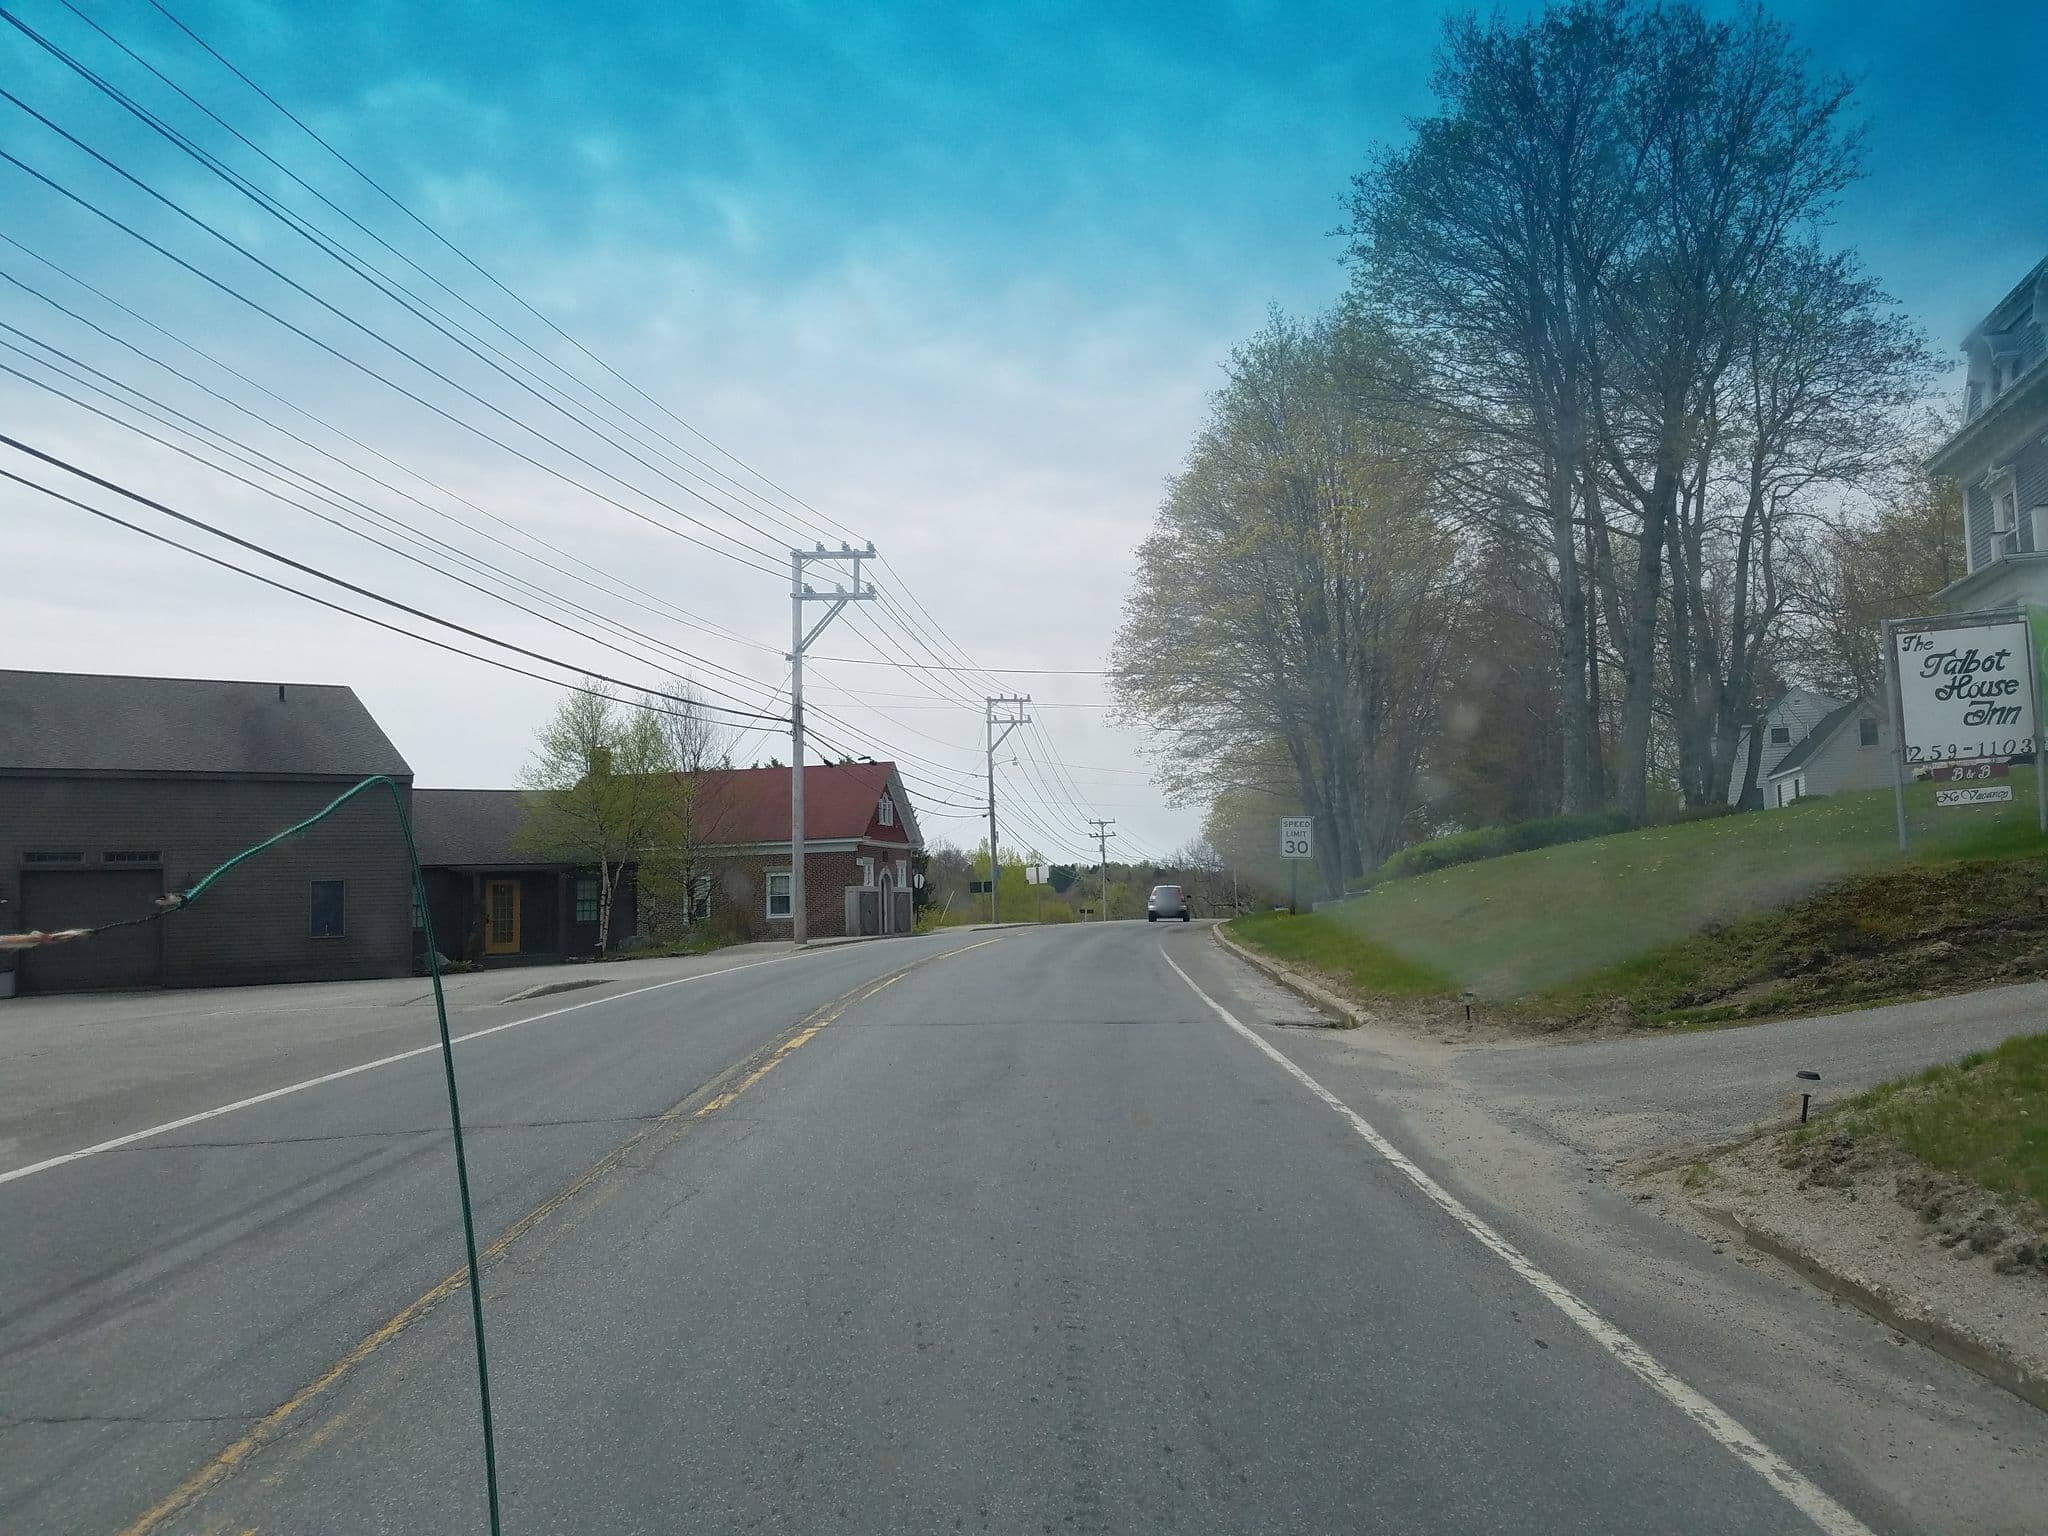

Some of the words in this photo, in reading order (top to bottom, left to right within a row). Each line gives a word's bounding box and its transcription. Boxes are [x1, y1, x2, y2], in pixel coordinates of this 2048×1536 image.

[1902, 634, 1934, 652] The
[1919, 648, 2012, 679] Talbot
[1935, 674, 2019, 700] House
[1963, 700, 2023, 726] Inn
[1908, 738, 2033, 762] 259-1103
[1960, 788, 2009, 802] Vacancy
[1285, 841, 1309, 854] 30
